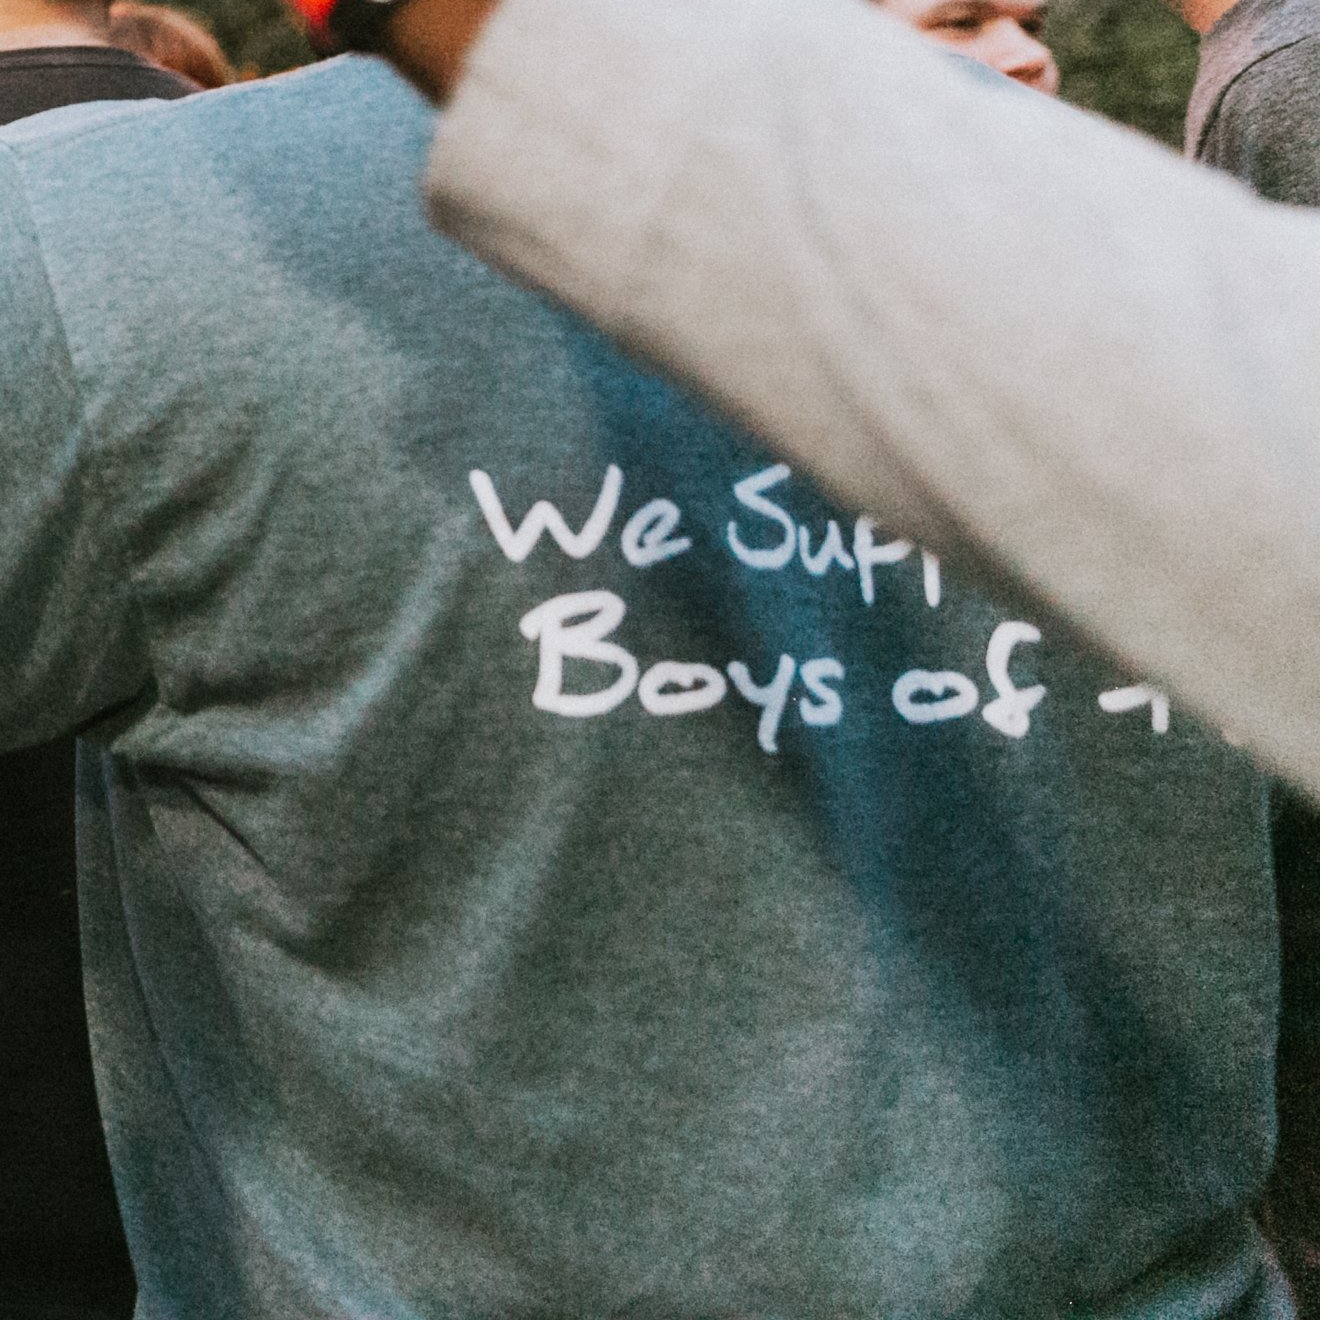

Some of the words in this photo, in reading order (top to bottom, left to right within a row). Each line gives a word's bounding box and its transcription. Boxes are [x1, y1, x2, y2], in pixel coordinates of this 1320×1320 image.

[469, 465, 691, 568] We
[520, 589, 844, 753] Boys
[892, 621, 1047, 739] of
